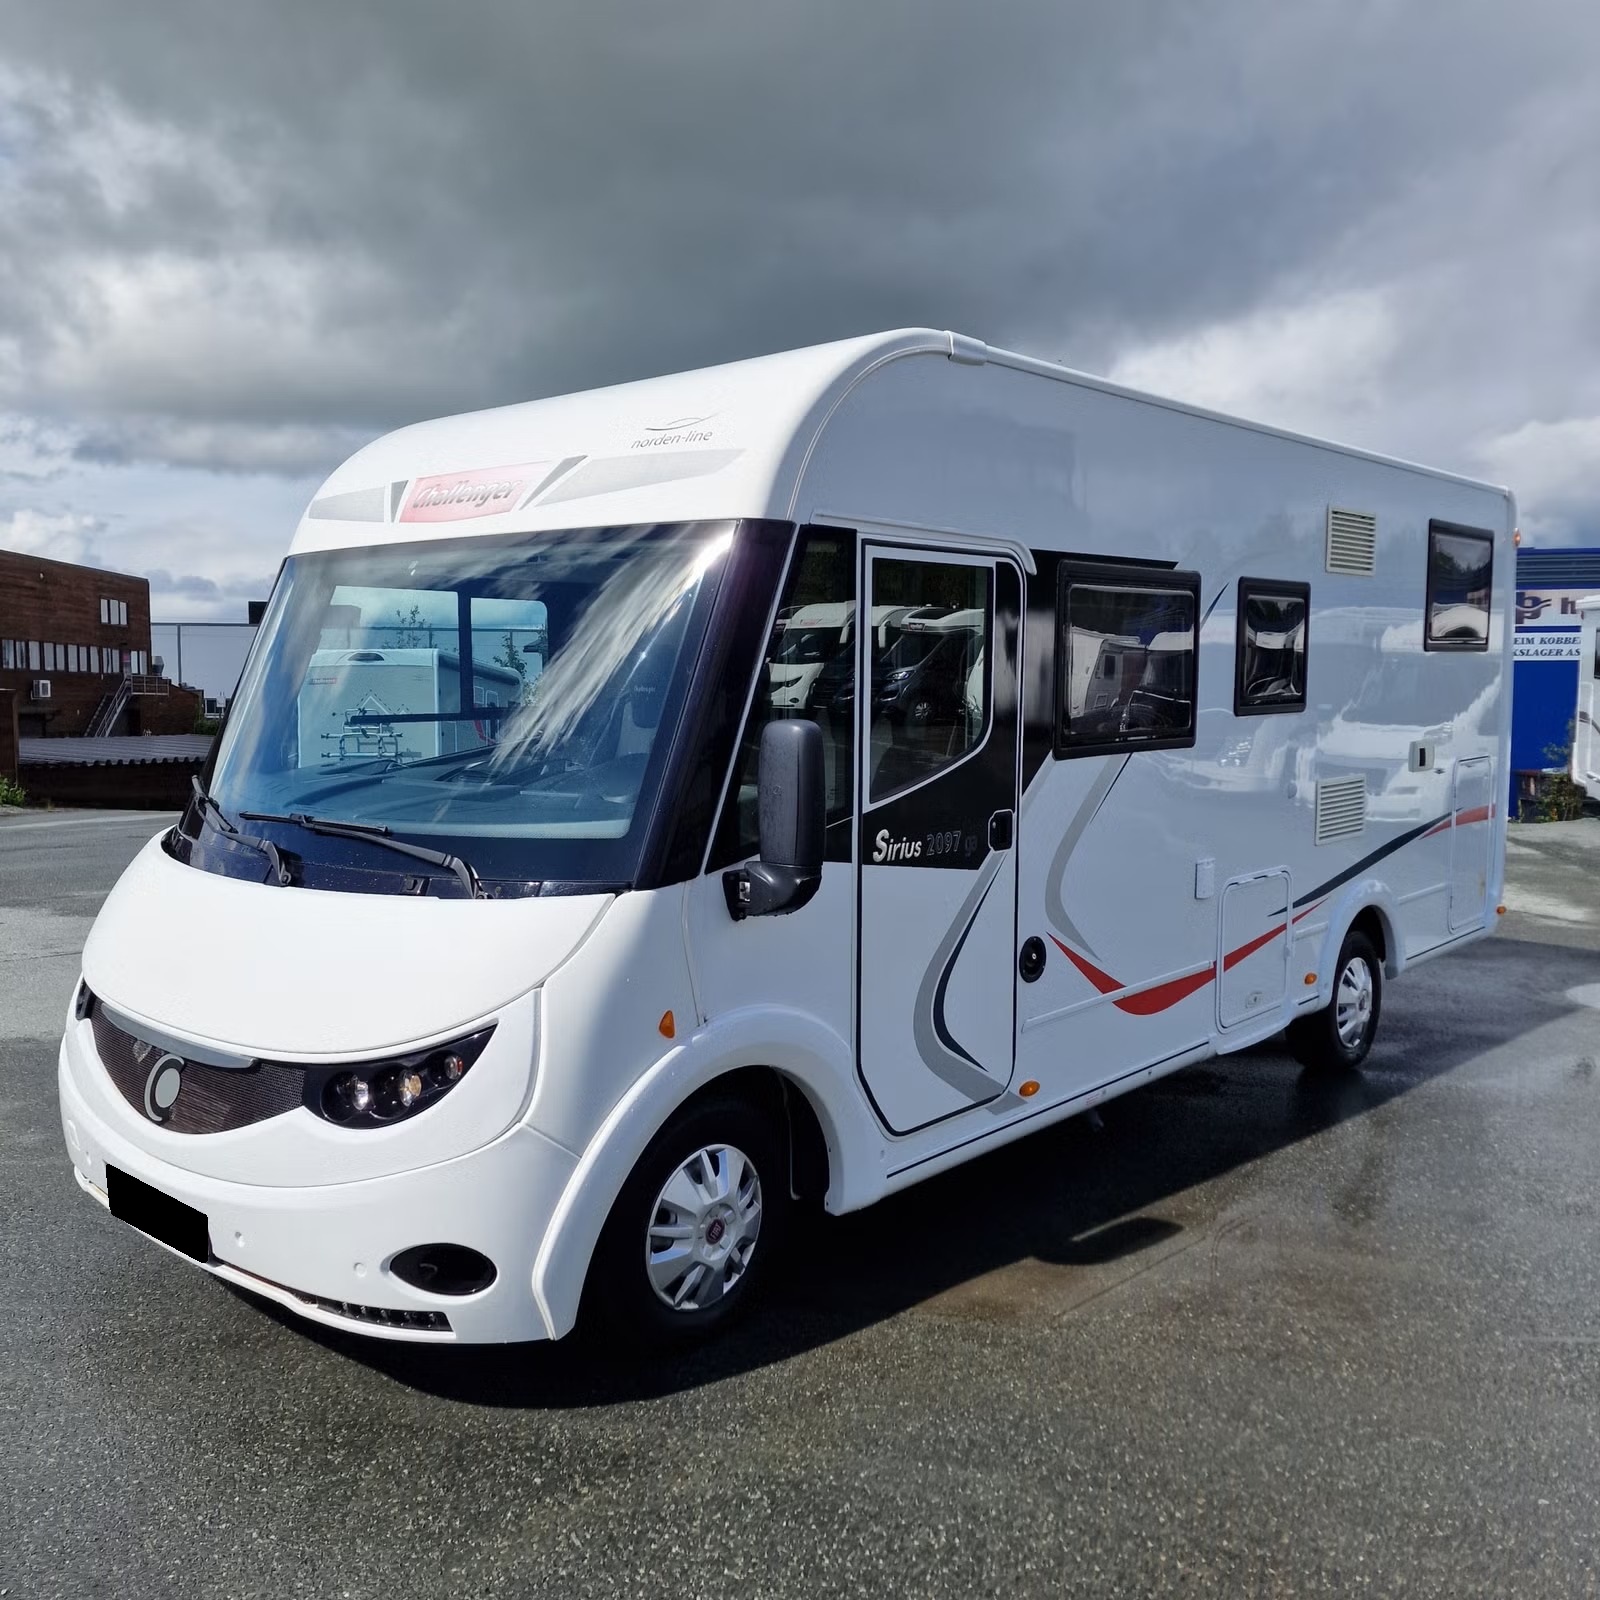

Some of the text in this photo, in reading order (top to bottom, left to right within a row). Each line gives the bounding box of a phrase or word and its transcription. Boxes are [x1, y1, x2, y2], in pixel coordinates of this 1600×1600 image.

[631, 430, 714, 449] norden-line
[872, 828, 922, 863] Sirius
[926, 830, 962, 856] 2097
